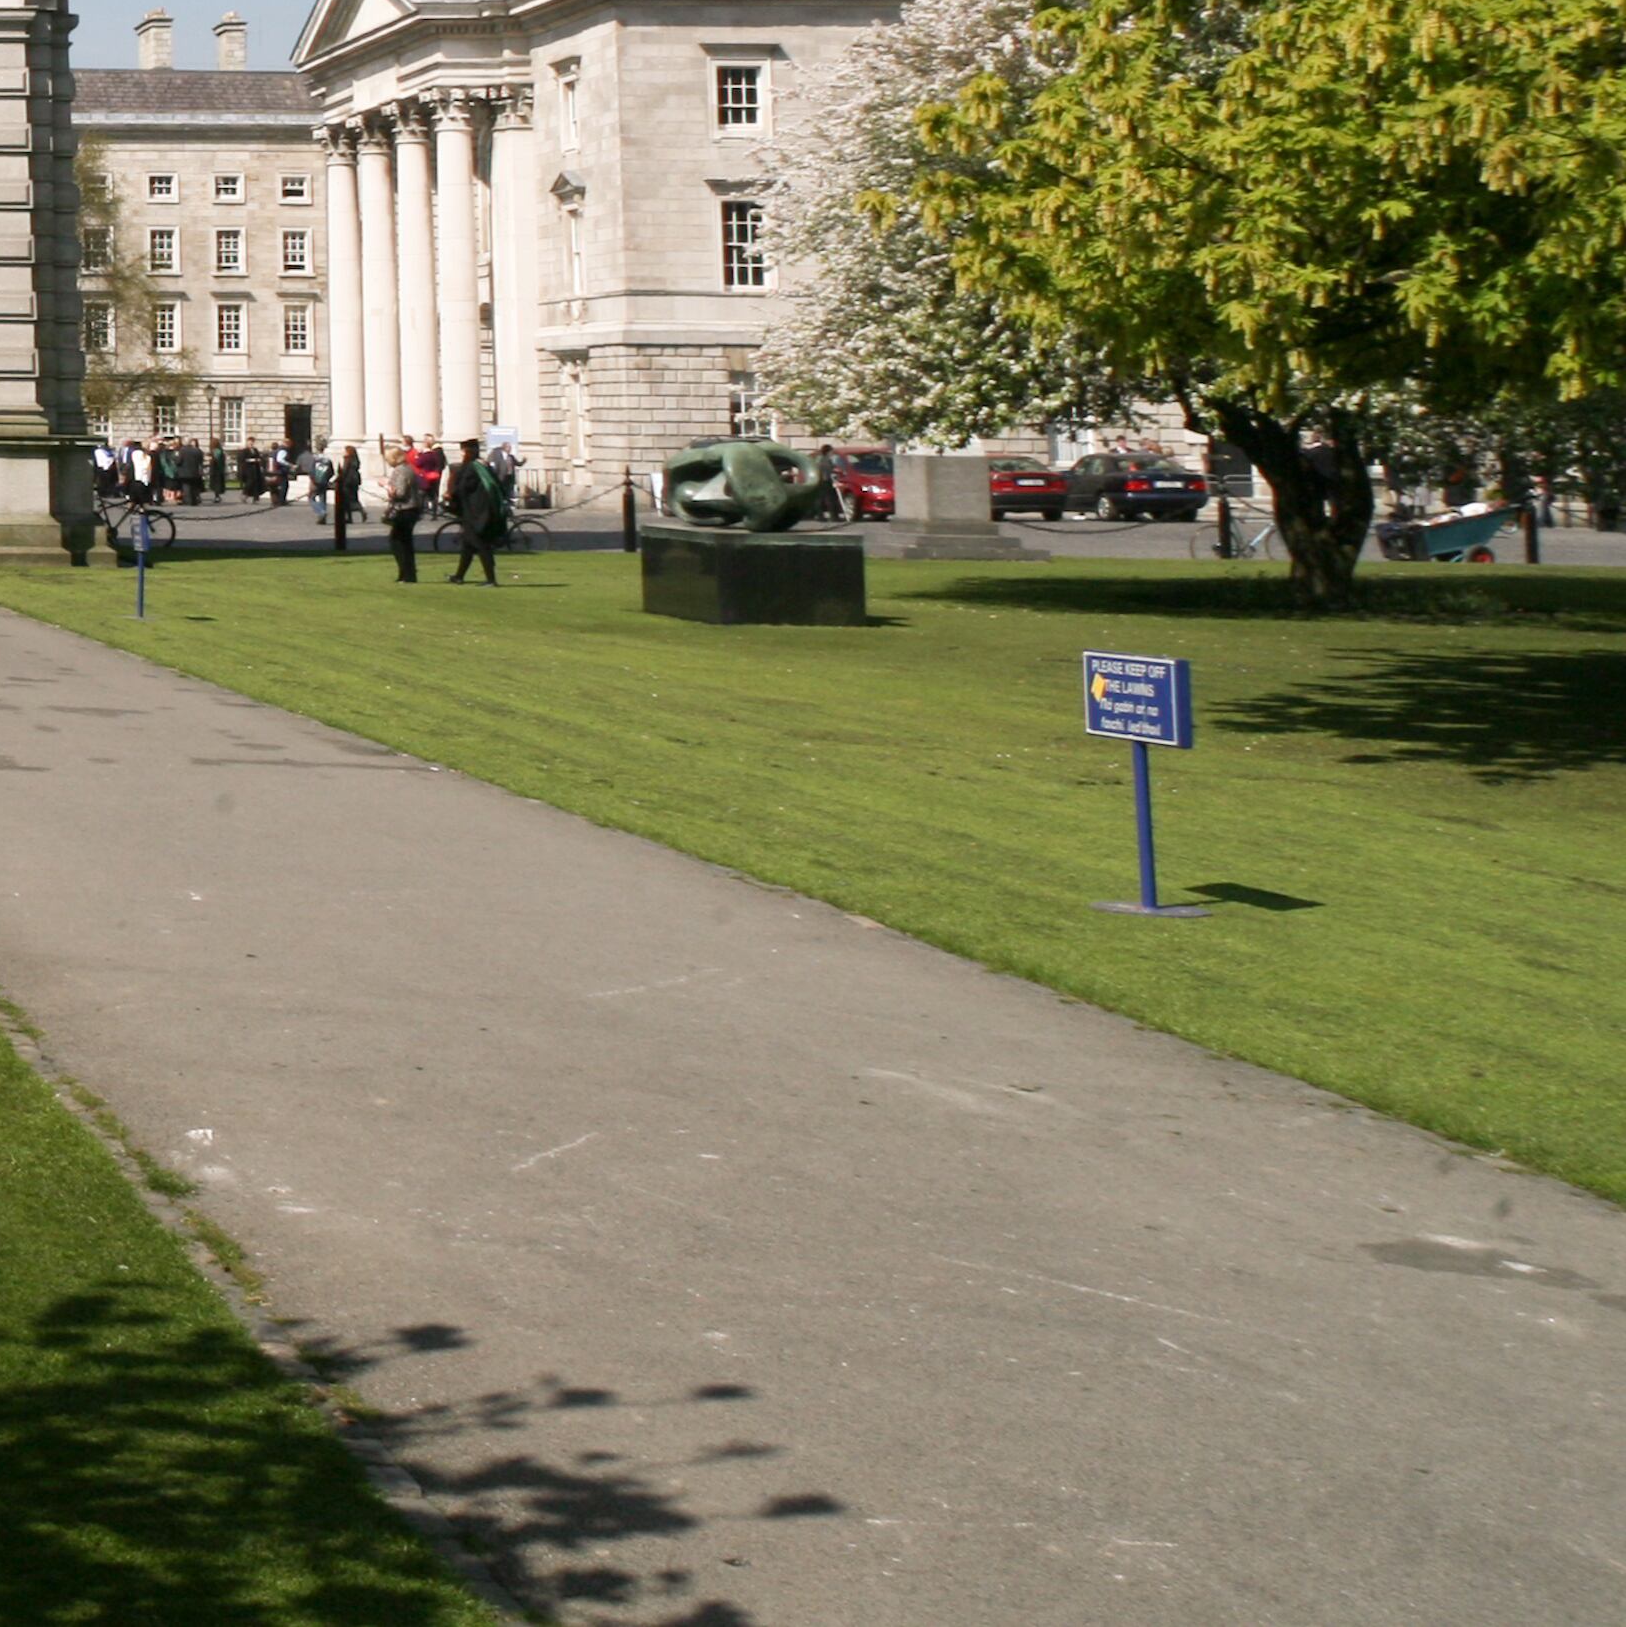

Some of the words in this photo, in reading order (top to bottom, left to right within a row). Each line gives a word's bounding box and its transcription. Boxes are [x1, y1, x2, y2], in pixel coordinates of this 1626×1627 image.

[1091, 659, 1124, 675] PLEASE
[1125, 663, 1147, 677] KEEP
[1148, 665, 1166, 679] OFF
[1103, 678, 1121, 694] THE
